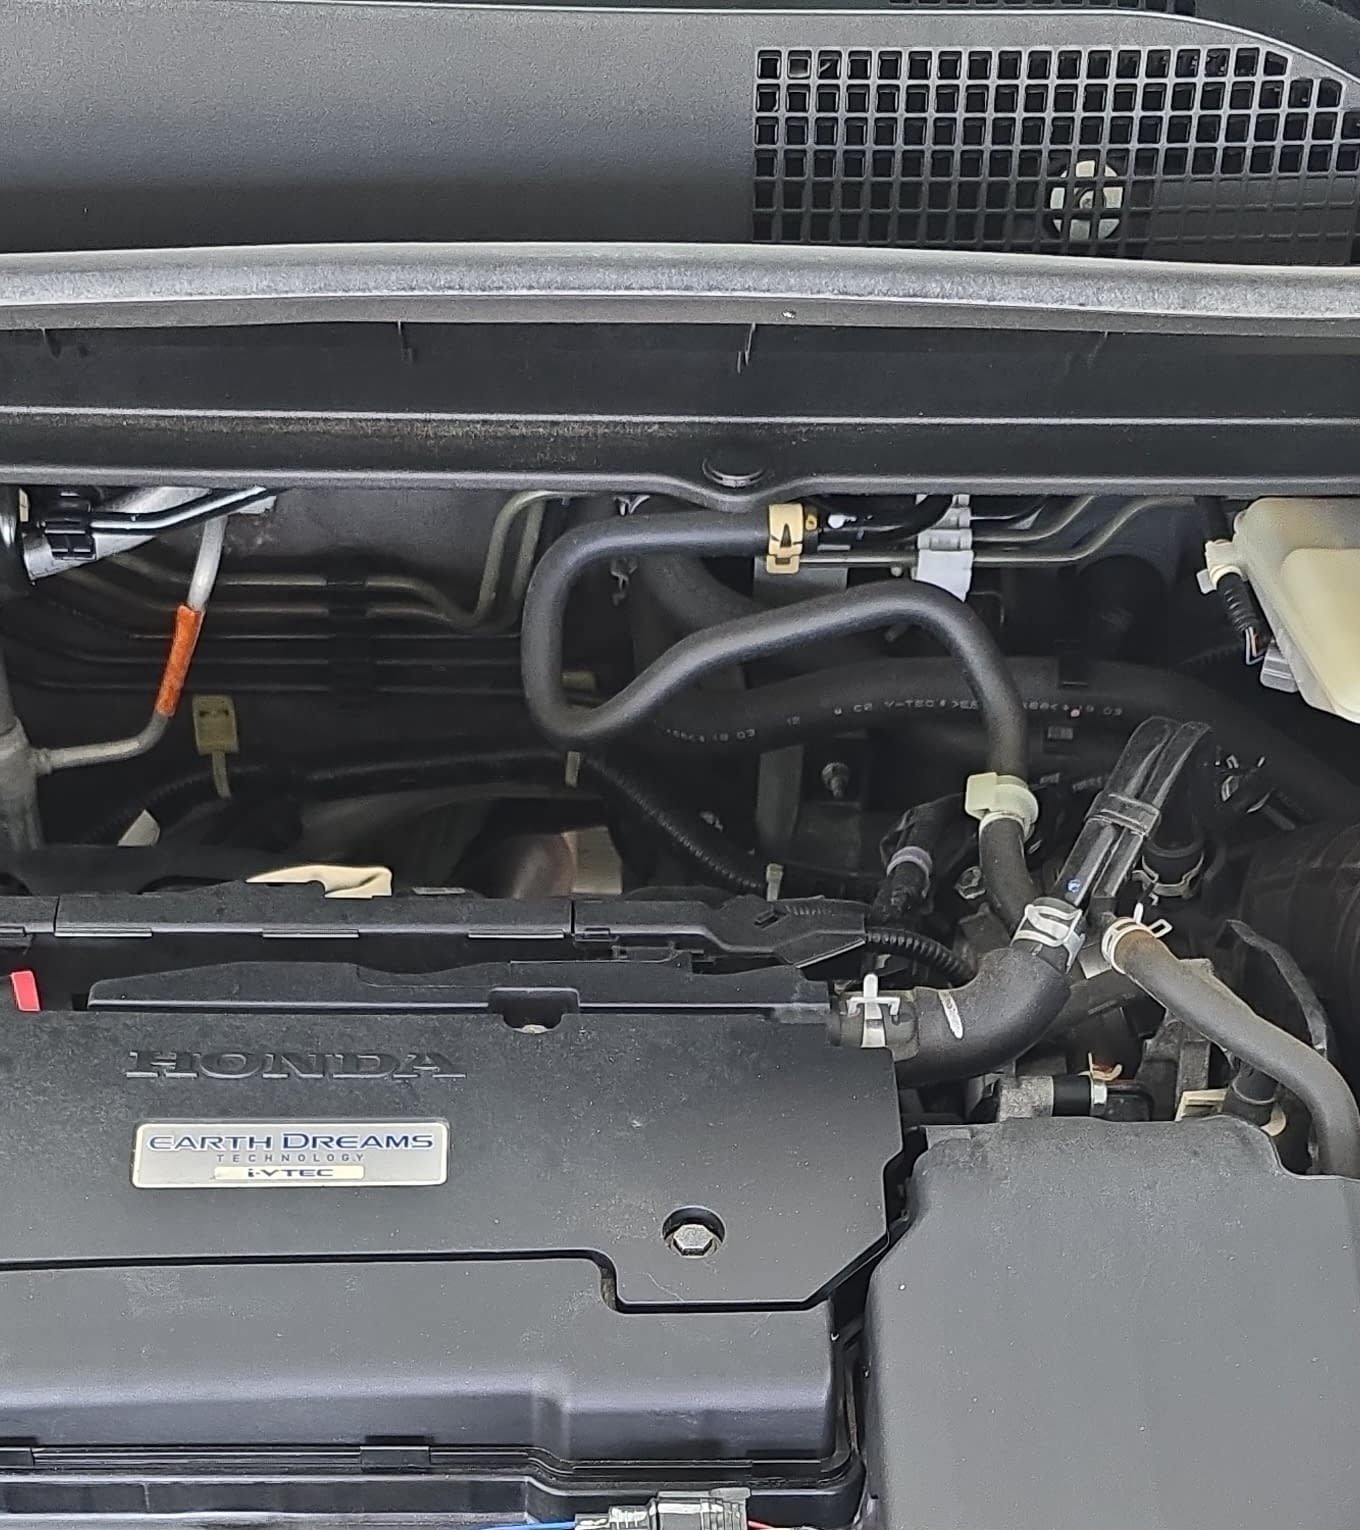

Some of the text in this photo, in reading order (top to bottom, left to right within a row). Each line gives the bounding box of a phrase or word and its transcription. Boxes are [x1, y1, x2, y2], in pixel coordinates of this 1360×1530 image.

[126, 1051, 467, 1080] HONDA
[148, 1132, 434, 1150] EARTH DREAMS
[216, 1153, 365, 1163] TECHNOLOGY
[246, 1167, 334, 1178] i-VTEC
